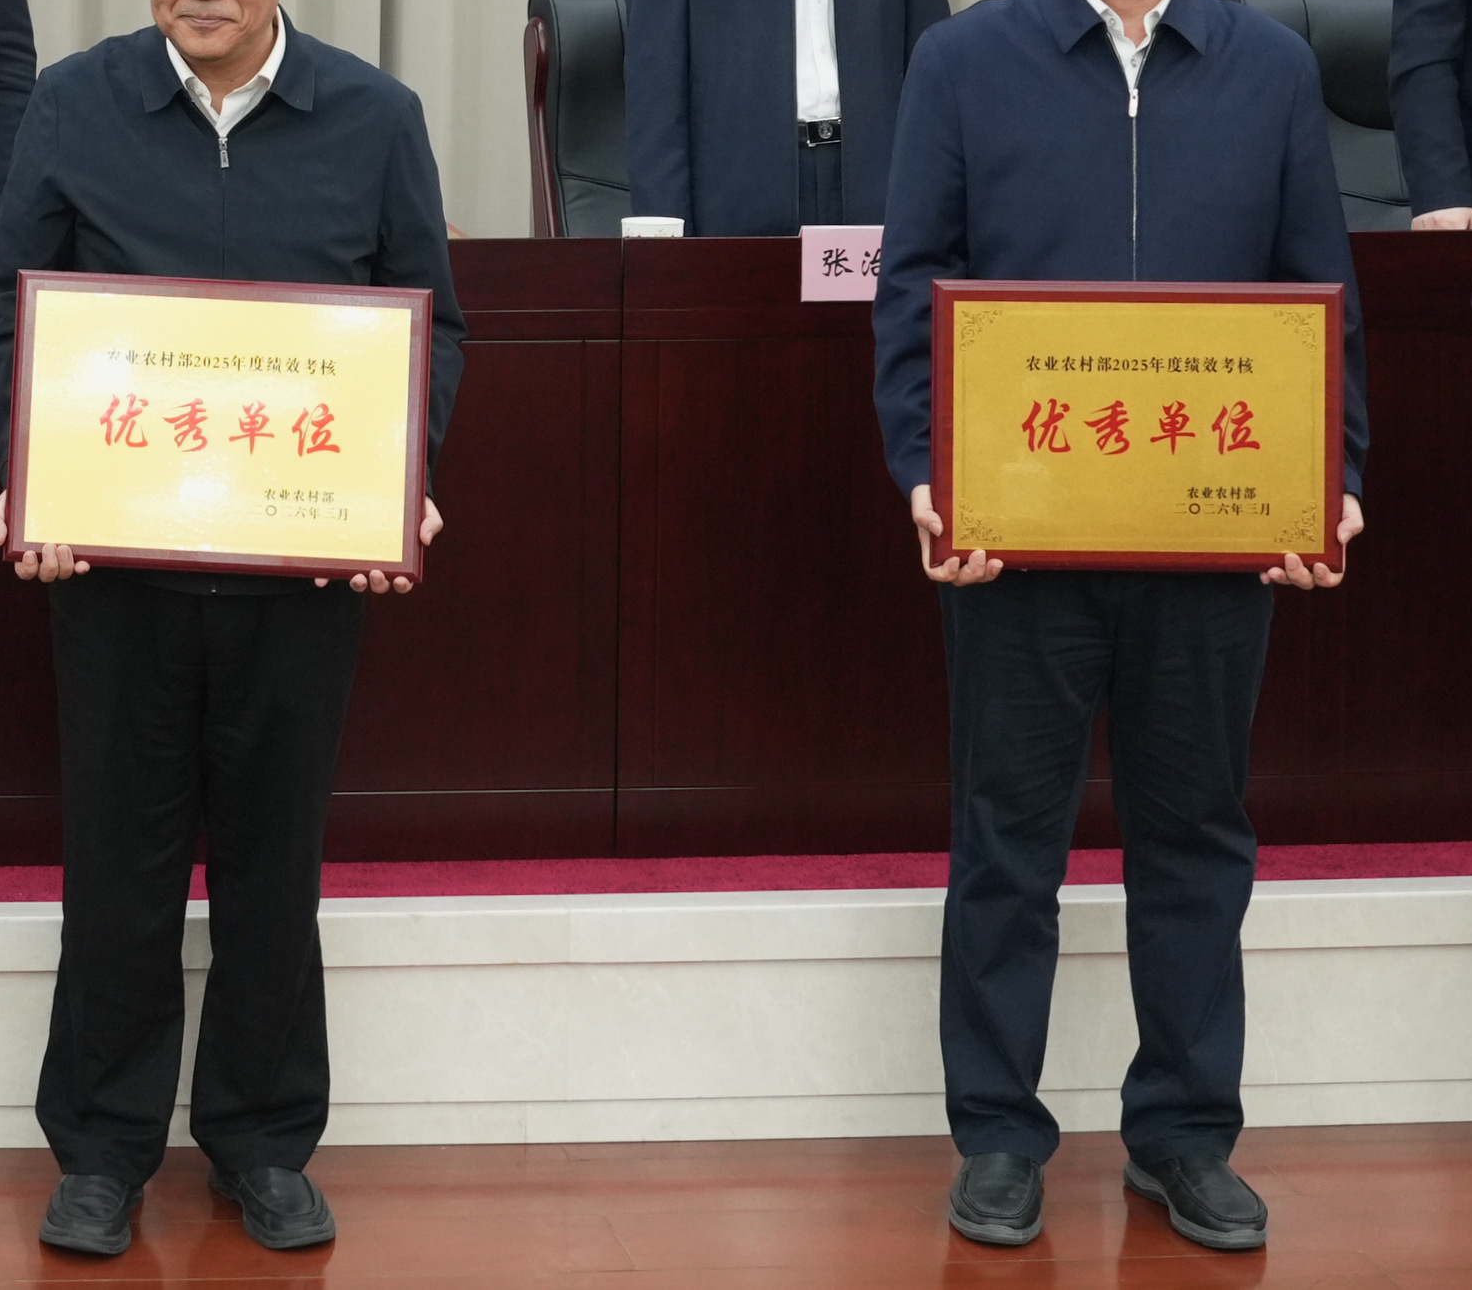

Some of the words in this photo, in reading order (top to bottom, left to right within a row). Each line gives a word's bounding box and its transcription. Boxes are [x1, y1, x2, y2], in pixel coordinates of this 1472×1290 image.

[108, 348, 336, 376] 农业农村部2025年度绩效考核
[1026, 356, 1254, 374] 农业农村部2025年度绩效考核
[100, 393, 341, 457] 优秀单位
[1022, 398, 1261, 455] 优秀单位
[264, 489, 335, 503] 农业农村部
[1187, 487, 1256, 500] 农业农村部
[1174, 502, 1270, 516] 二〇二六年三月
